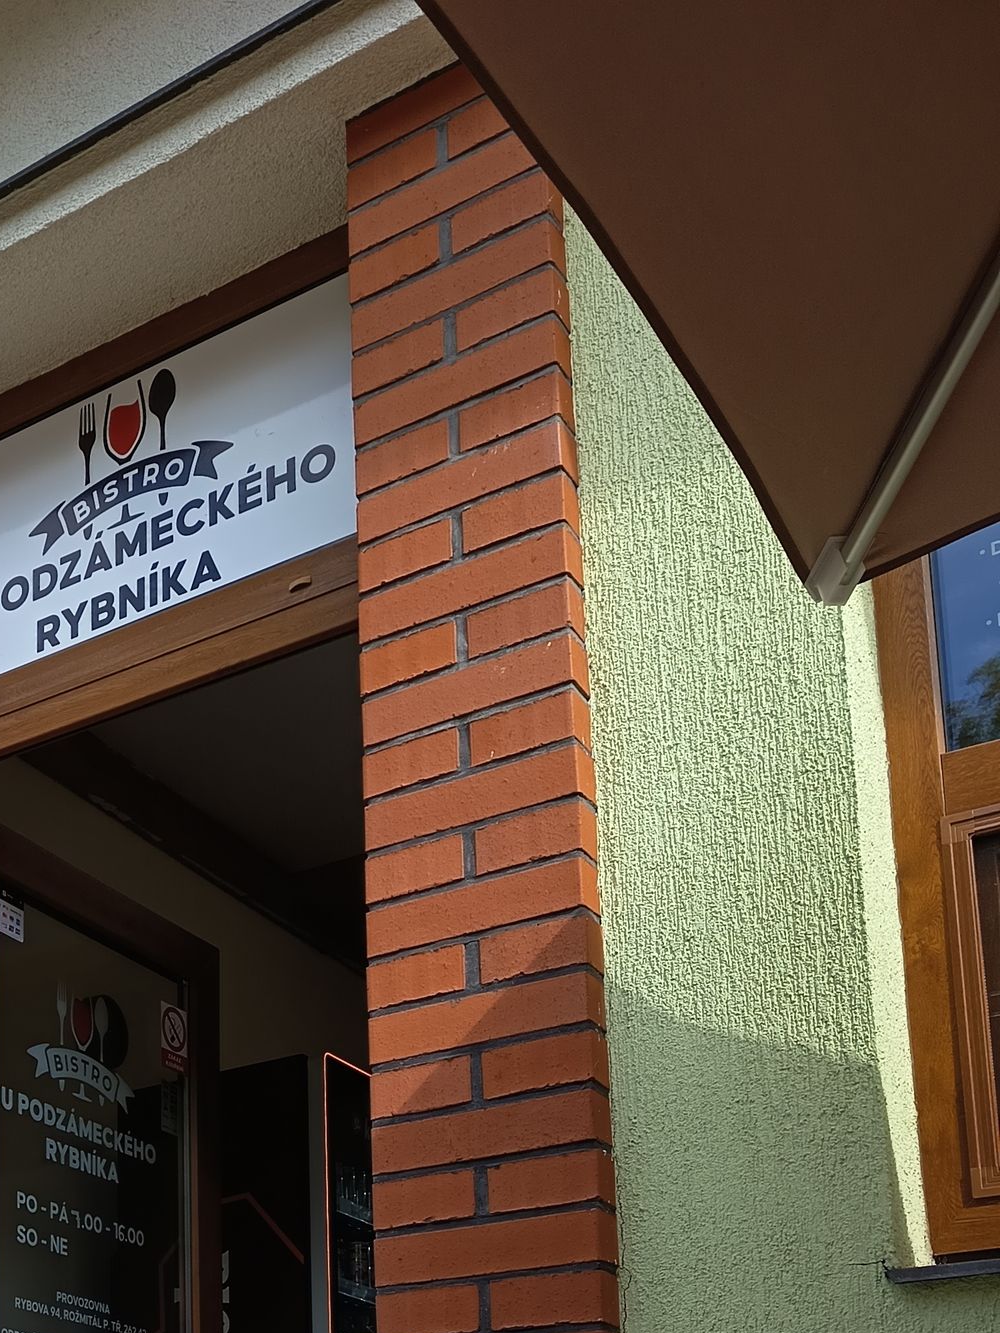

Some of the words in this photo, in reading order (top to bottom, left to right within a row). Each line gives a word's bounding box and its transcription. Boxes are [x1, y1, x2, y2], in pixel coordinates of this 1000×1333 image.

[74, 458, 185, 521] BISTRO
[36, 550, 222, 653] RYBNÍKA
[54, 1053, 113, 1093] BISTRO
[0, 1086, 14, 1111] U
[17, 1093, 157, 1164] PODZÁMECKÉHO
[45, 1137, 120, 1183] RYBNÍKA
[16, 1190, 38, 1214] PO
[50, 1202, 69, 1224] PÁ
[113, 1222, 145, 1247] 16.00
[16, 1224, 38, 1247] SO
[50, 1234, 69, 1256] NE
[14, 1297, 49, 1316] RYBOVA
[63, 1309, 102, 1328] ROŽMITÁL
[56, 1291, 111, 1315] PROVOZOVNA
